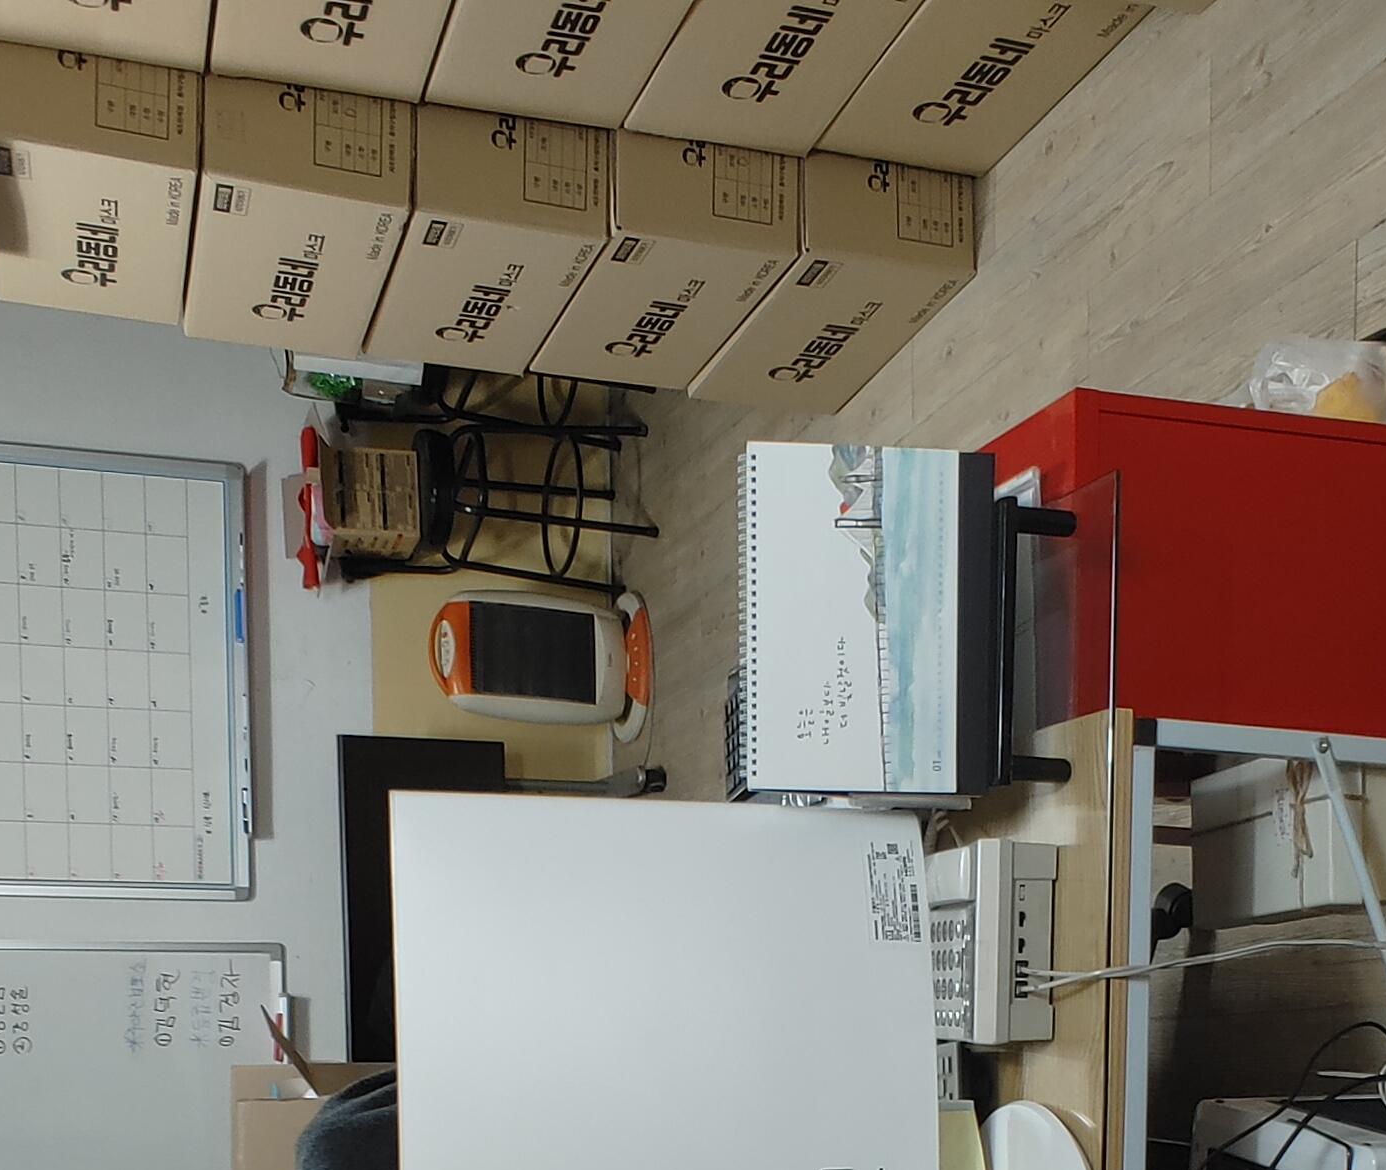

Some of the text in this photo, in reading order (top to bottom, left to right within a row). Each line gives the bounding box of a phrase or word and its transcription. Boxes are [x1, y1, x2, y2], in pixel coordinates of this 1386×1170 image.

[1096, 14, 1131, 38] Made
[720, 4, 836, 104] 우리동네
[911, 4, 1072, 126] 우리동네 마스크
[169, 177, 183, 200] KOREA
[165, 208, 180, 226] Made
[373, 212, 393, 236] KOREA
[60, 198, 119, 287] 우리동네 마스크
[366, 244, 383, 260] Made
[571, 243, 596, 264] KOREA
[251, 234, 327, 322] 우리동네 마스크
[434, 284, 513, 343] 우리동네
[497, 263, 525, 287] 마스크
[604, 279, 707, 358] 우리동네 마스크
[767, 301, 883, 383] 우리동네 마스크
[797, 708, 815, 739] 오늘은
[820, 680, 835, 744] 내일보다
[839, 714, 848, 728] 더
[932, 760, 942, 772] 01
